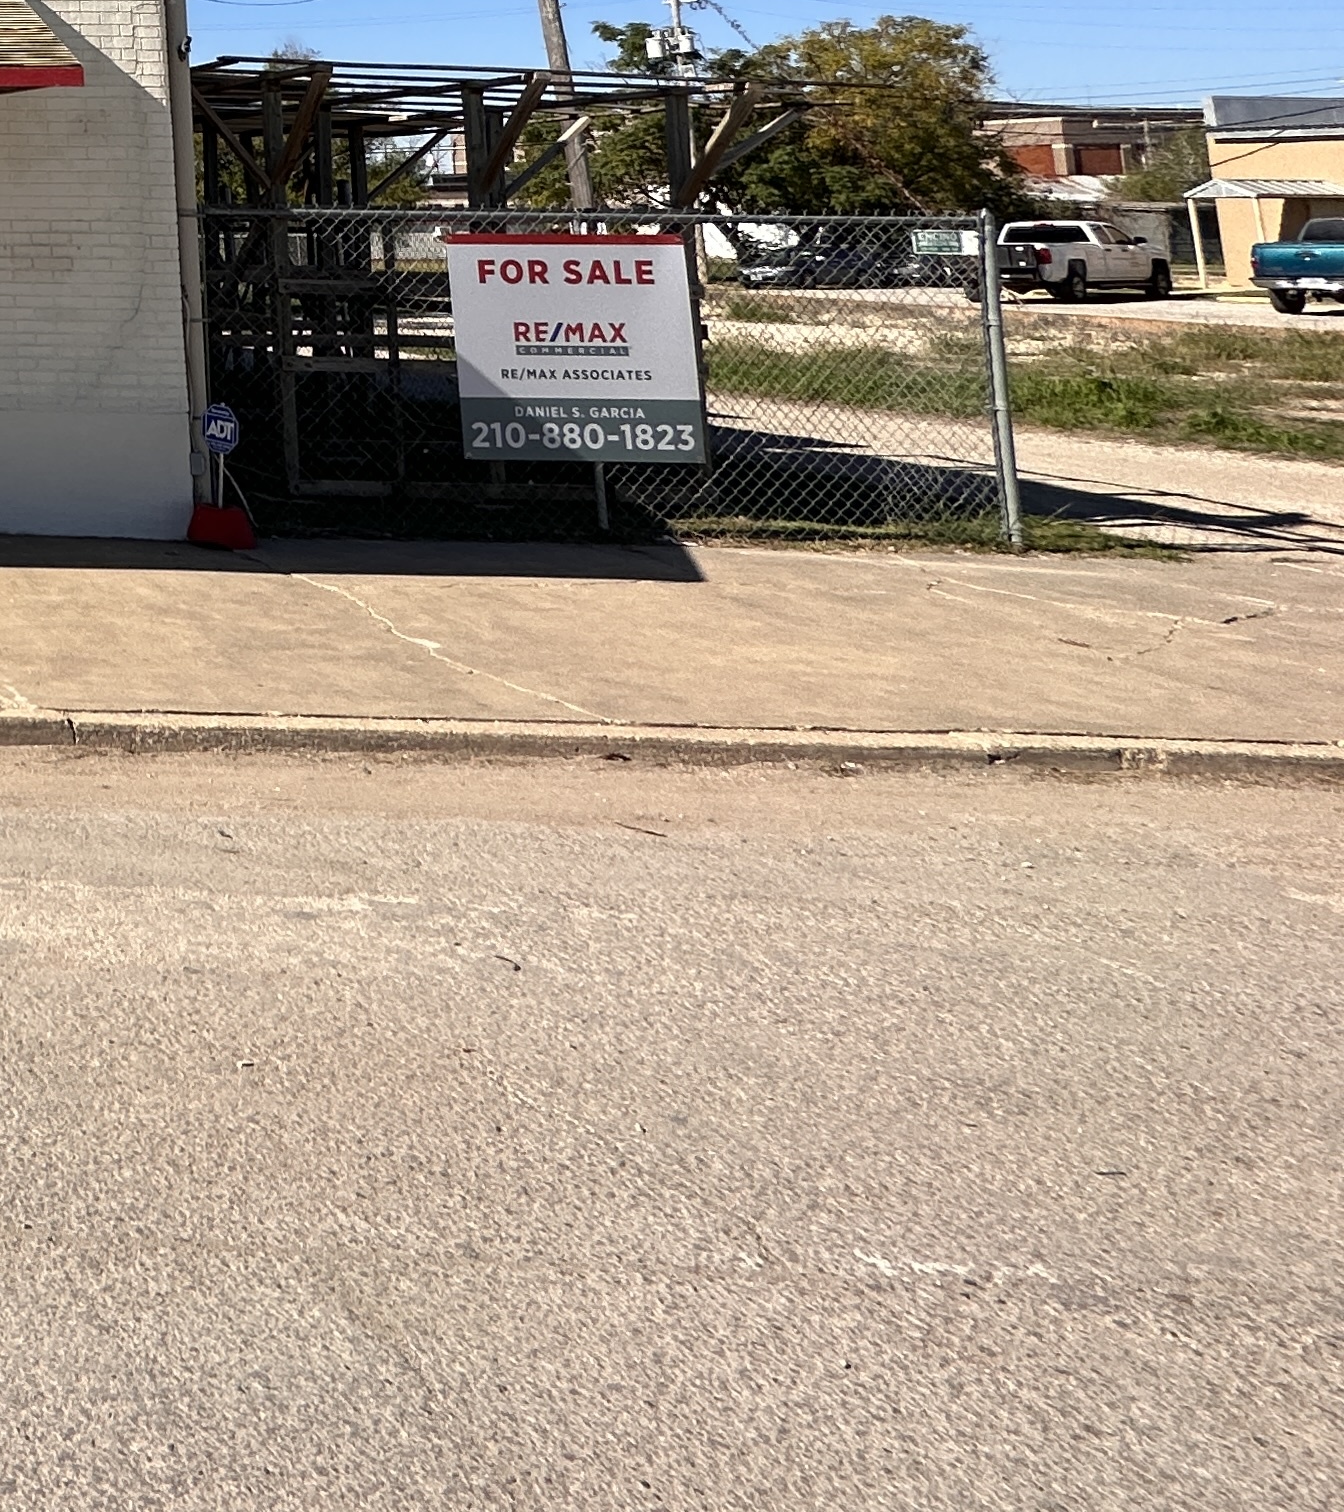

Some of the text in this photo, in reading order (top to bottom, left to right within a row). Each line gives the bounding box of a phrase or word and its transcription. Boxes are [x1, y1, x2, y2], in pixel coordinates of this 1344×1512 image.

[477, 259, 655, 285] FOR SALE
[513, 322, 627, 343] RE/MAX
[518, 346, 627, 356] COMMERCIAL
[501, 368, 652, 381] RE/MAX ASSOCIATES
[515, 406, 645, 419] DANIEL S. GARCIA
[206, 419, 234, 440] ADT
[471, 422, 695, 451] 210-880-1823
